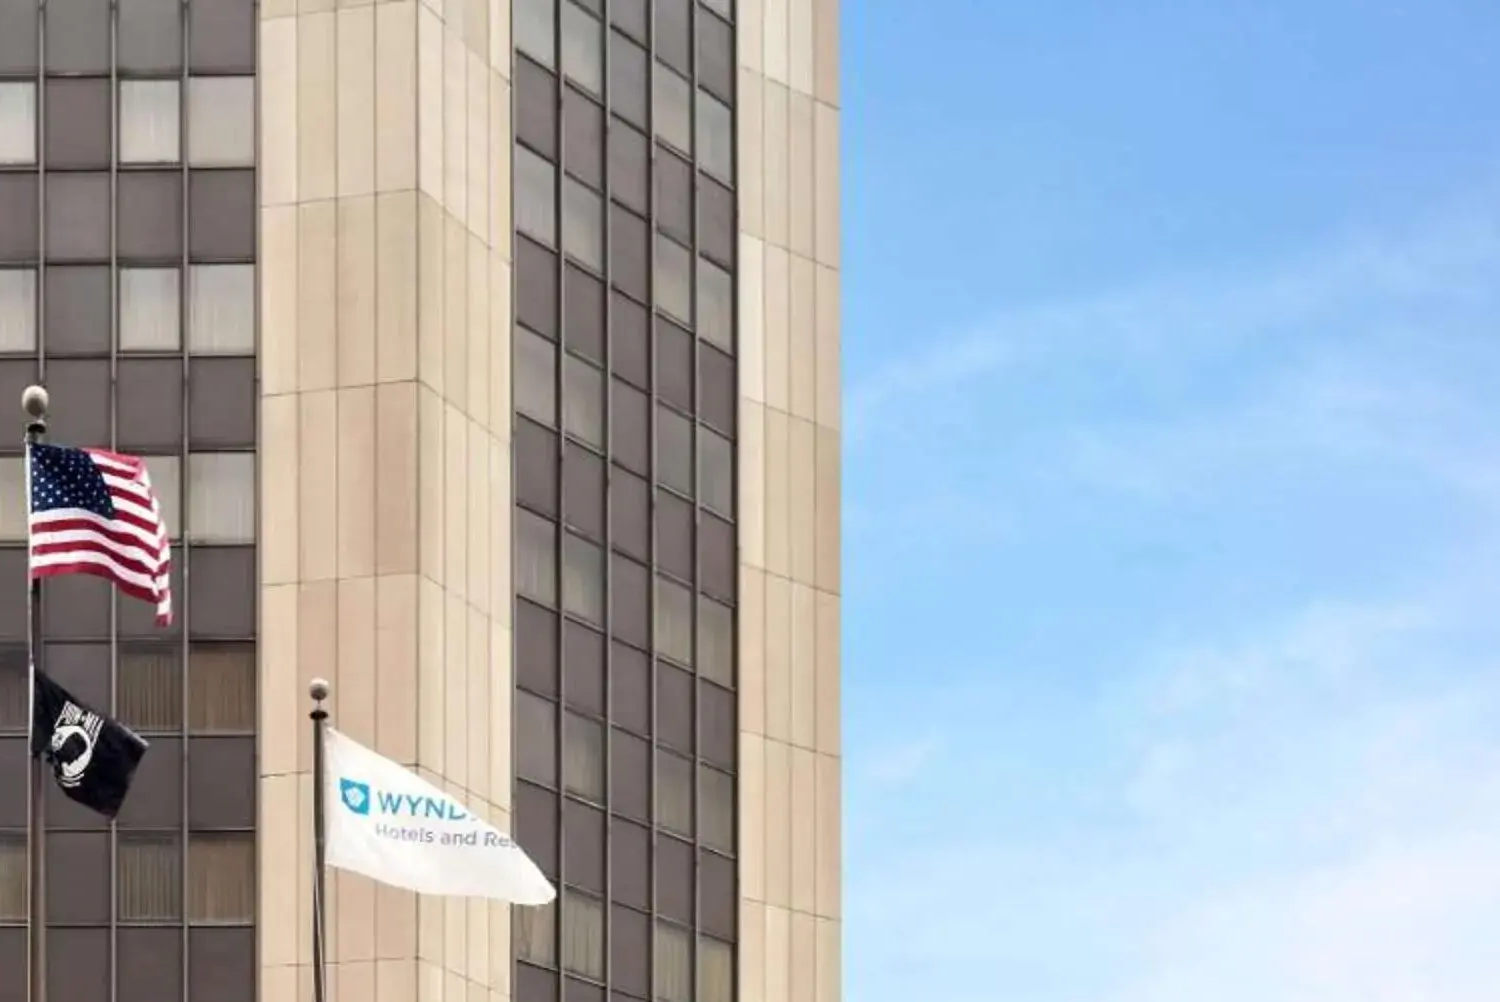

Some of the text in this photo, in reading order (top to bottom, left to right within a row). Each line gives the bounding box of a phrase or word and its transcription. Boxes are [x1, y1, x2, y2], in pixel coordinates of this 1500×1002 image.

[377, 790, 476, 821] WYND
[375, 823, 434, 844] Hotels
[440, 831, 478, 847] and
